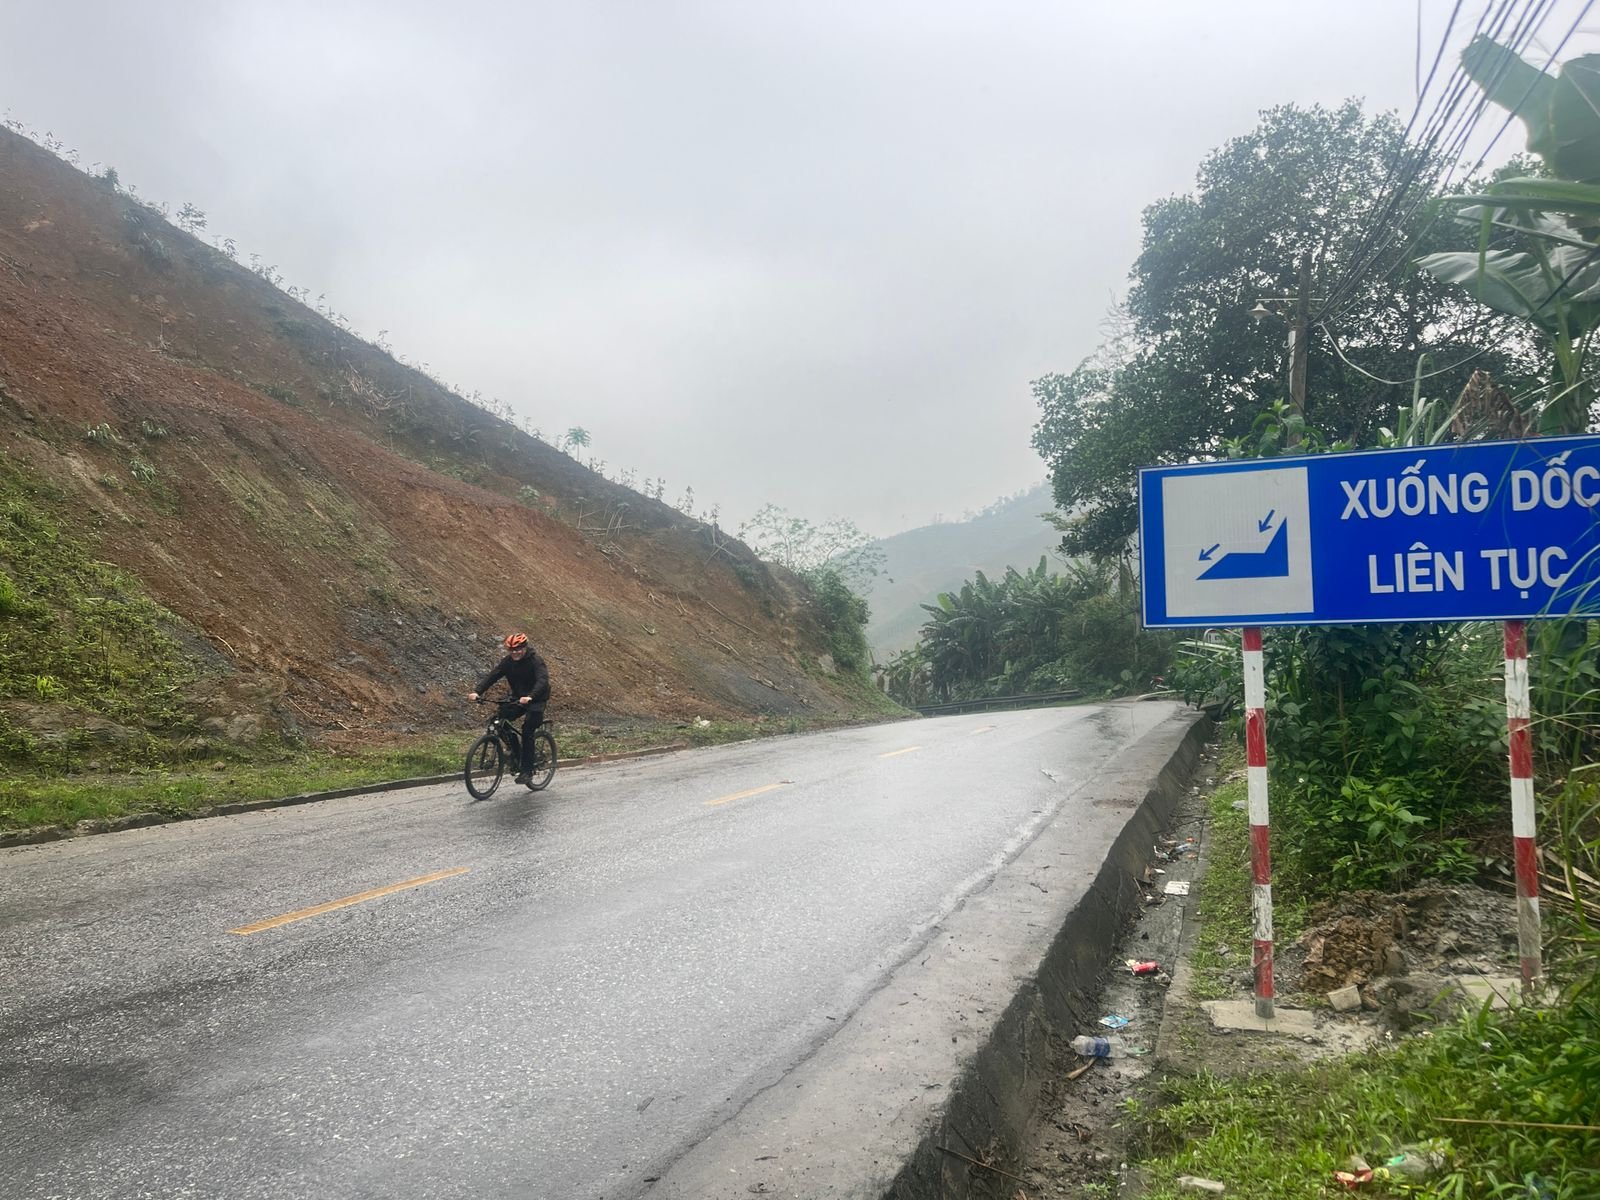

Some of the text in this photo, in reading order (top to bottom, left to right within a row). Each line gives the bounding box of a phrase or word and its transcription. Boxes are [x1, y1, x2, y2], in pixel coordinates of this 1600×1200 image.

[1340, 450, 1600, 520] XUỐNG DỐC
[1368, 541, 1569, 599] LIÊN TỤC
